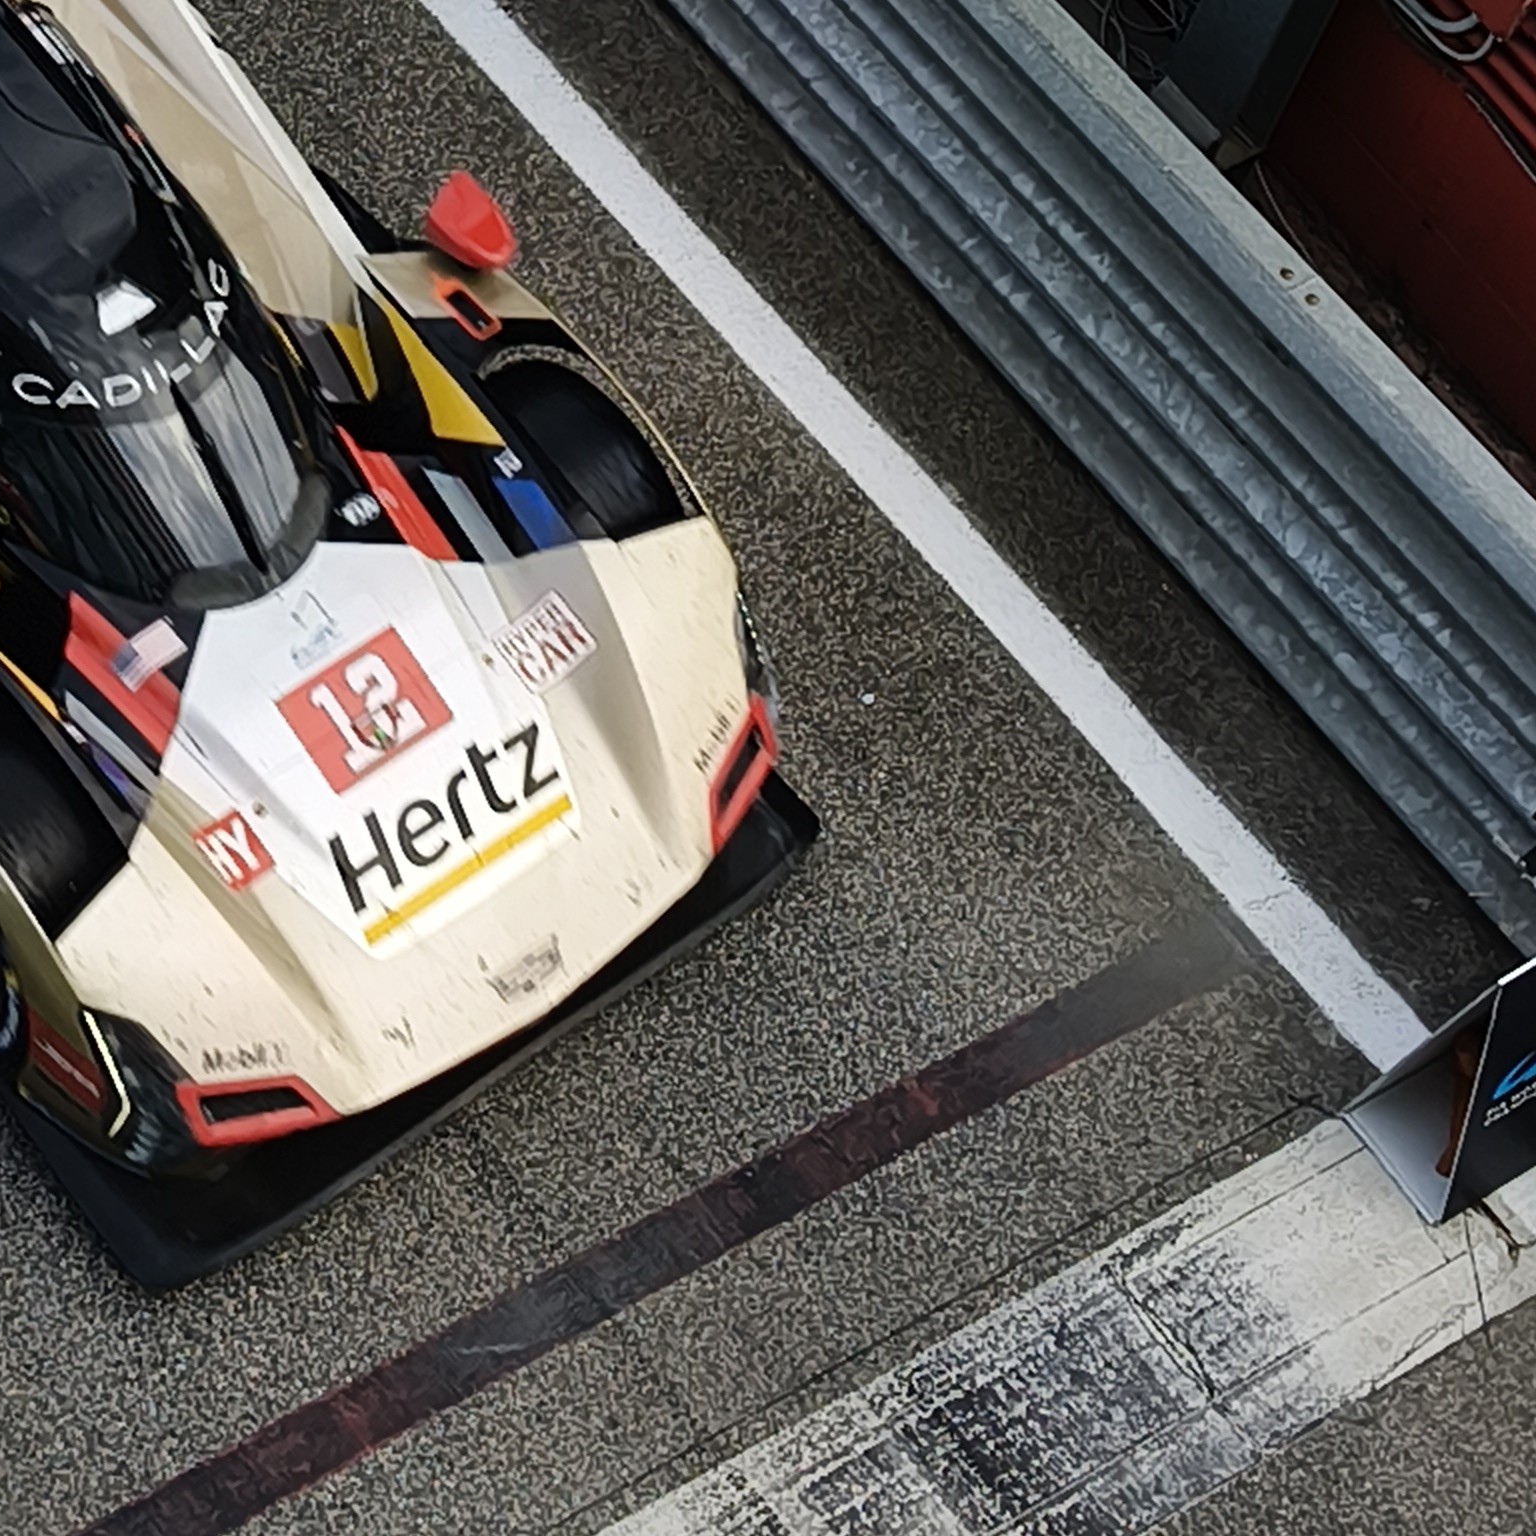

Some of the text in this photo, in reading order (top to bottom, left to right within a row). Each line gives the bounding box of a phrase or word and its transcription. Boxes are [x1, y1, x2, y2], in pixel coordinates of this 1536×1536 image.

[11, 258, 230, 410] CADILLAC
[517, 619, 588, 684] CAR
[310, 652, 428, 774] 12
[195, 817, 262, 884] HY
[328, 718, 560, 914] Hertz
